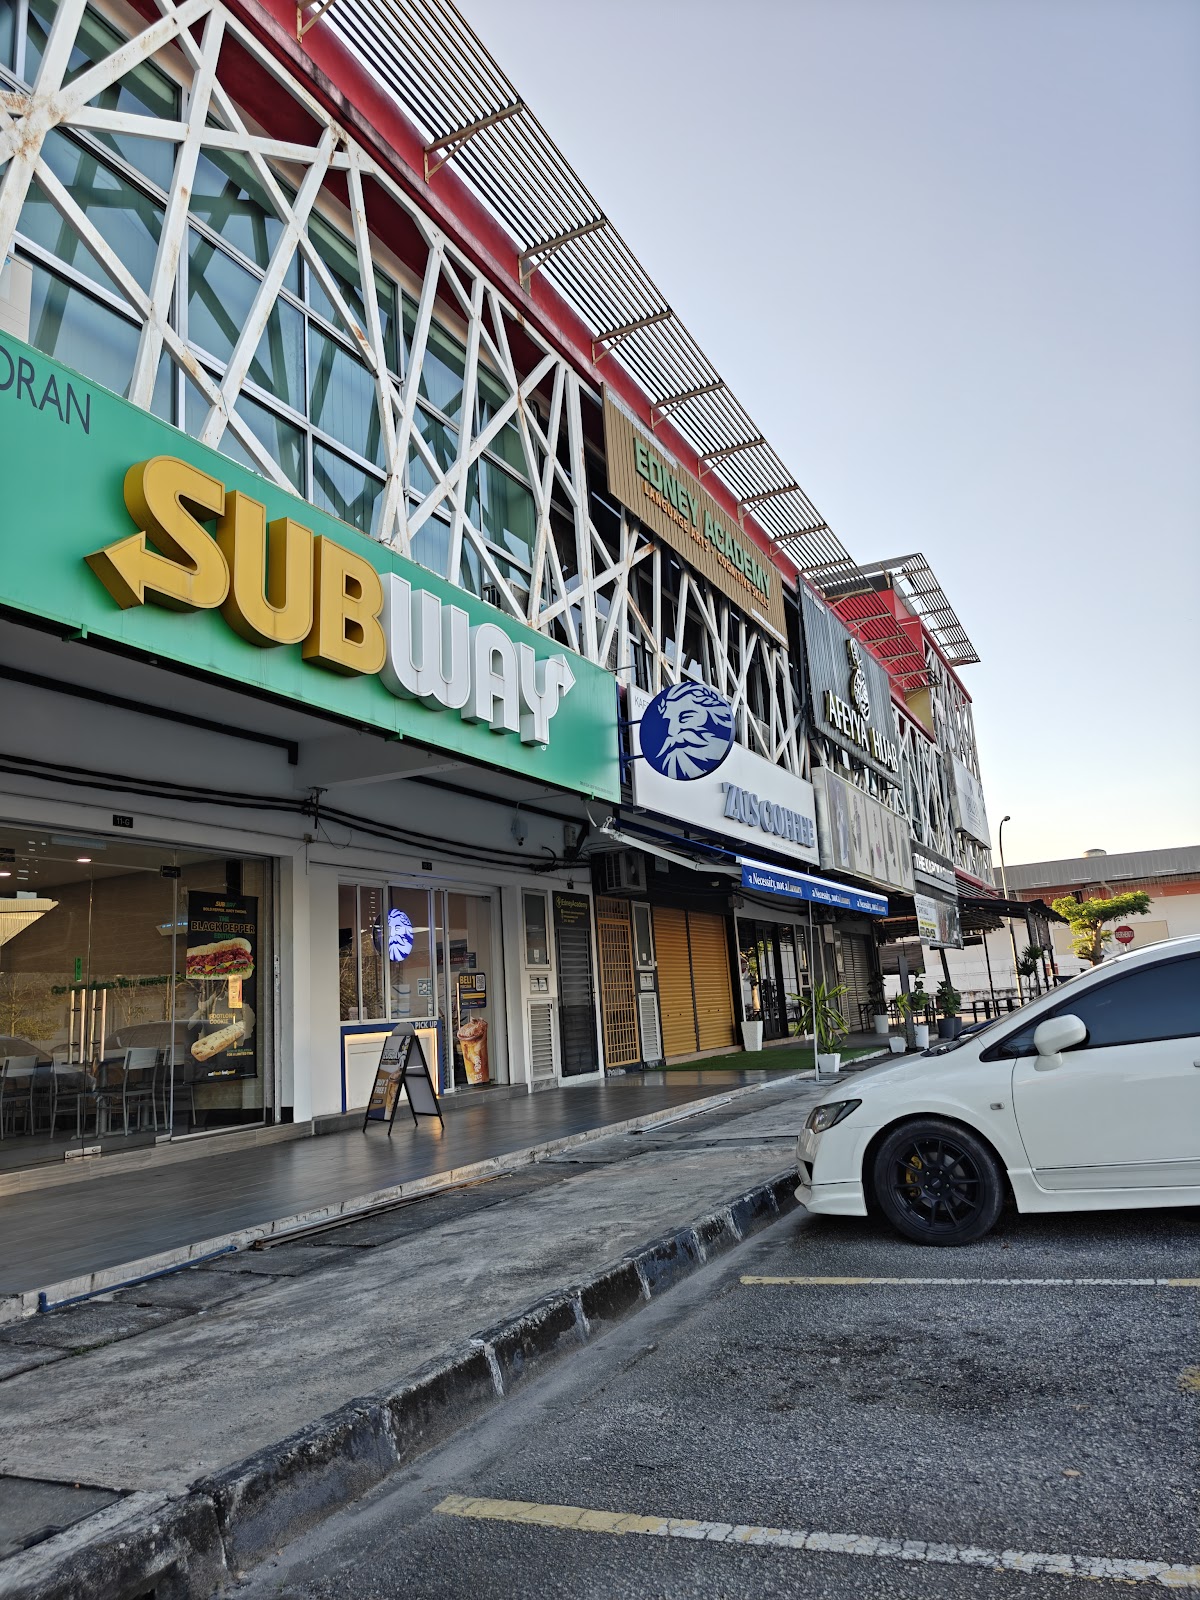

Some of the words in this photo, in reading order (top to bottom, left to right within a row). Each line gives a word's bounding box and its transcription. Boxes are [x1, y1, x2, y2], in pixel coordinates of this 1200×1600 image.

[633, 437, 699, 527] EDNEY
[704, 510, 771, 599] ACADEMY
[642, 480, 689, 534] LANGUAGE
[690, 526, 710, 551] ARTS
[717, 554, 752, 592] COGNITIVE
[752, 585, 770, 611] SKILLS
[84, 455, 577, 747] SUBWAY
[825, 689, 870, 752] AFEYYA
[870, 726, 899, 773] HIJAB
[720, 781, 761, 827] ZUS
[758, 799, 816, 849] COFFEE
[191, 920, 223, 933] BLACK
[222, 921, 256, 935] PEPPER
[459, 975, 472, 985] BELI
[414, 1021, 429, 1029] PICK
[429, 1020, 438, 1028] UP
